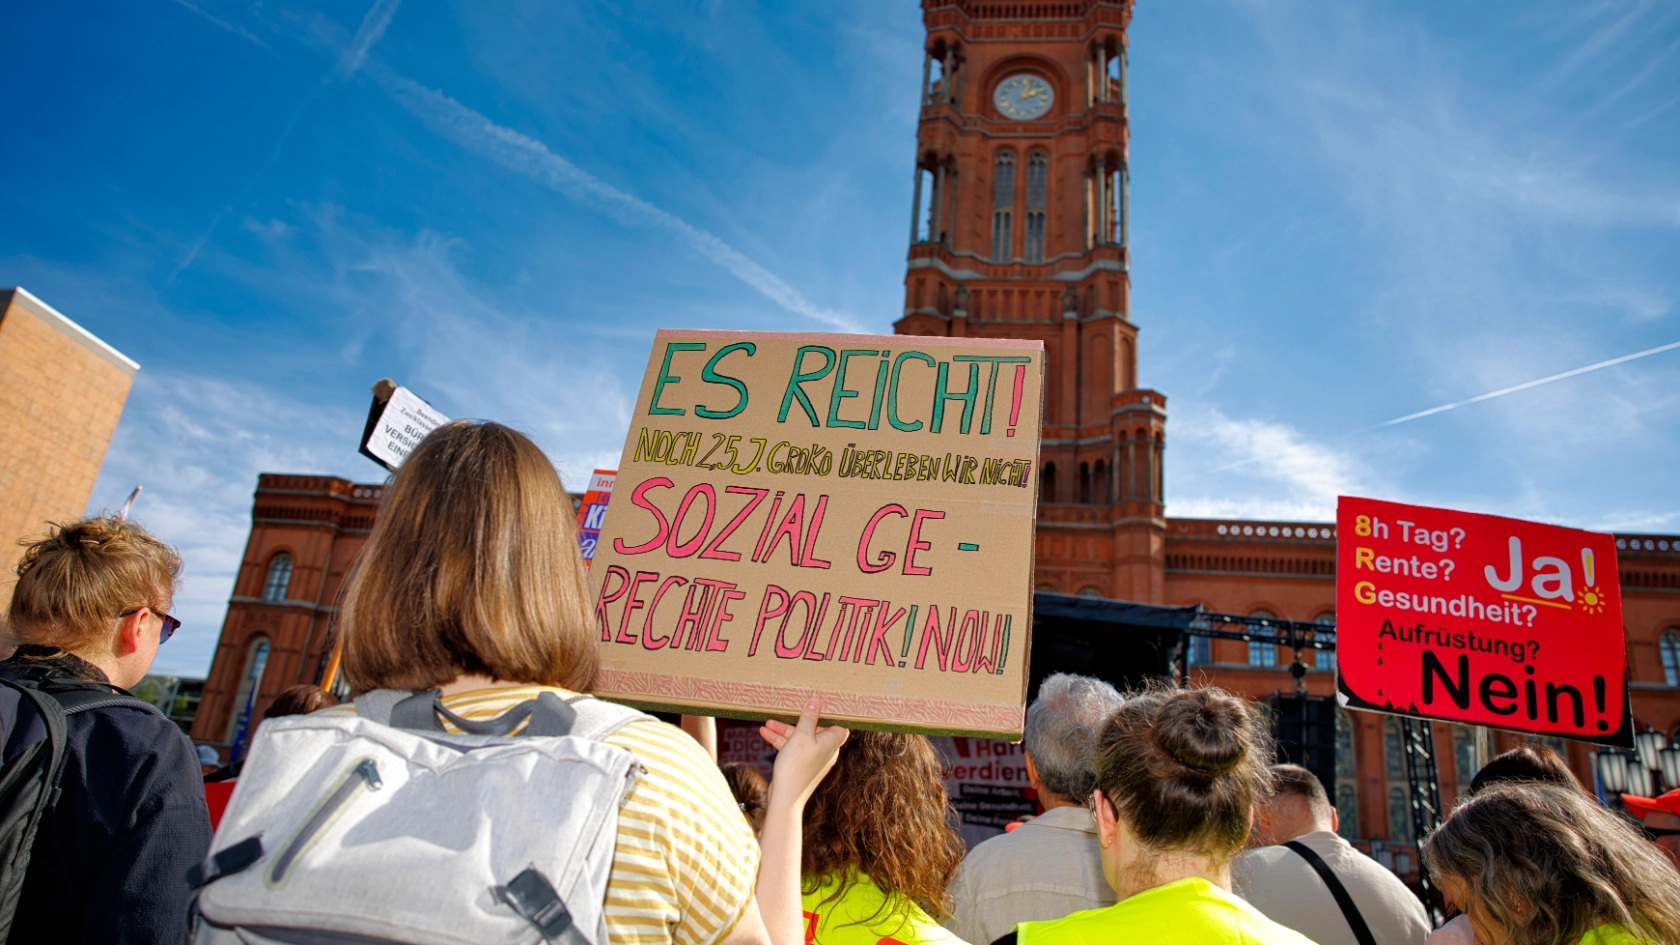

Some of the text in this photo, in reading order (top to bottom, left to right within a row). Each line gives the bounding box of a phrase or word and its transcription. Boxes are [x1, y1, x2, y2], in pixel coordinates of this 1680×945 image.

[648, 342, 757, 419] ES
[633, 427, 702, 466] NOCH
[731, 438, 768, 475] J.
[766, 441, 833, 476] GROKO
[838, 443, 942, 482] ÜBERLEBEN
[1355, 515, 1466, 553] 8h Tag?
[1355, 547, 1455, 581] Rente?
[1484, 535, 1600, 606] Ja!
[595, 564, 746, 652] RECHTE
[914, 604, 1012, 675] NOW!
[1354, 581, 1538, 628] Gesundheit?
[1378, 619, 1541, 663] Aufrüstung?
[1421, 649, 1610, 732] Nein!
